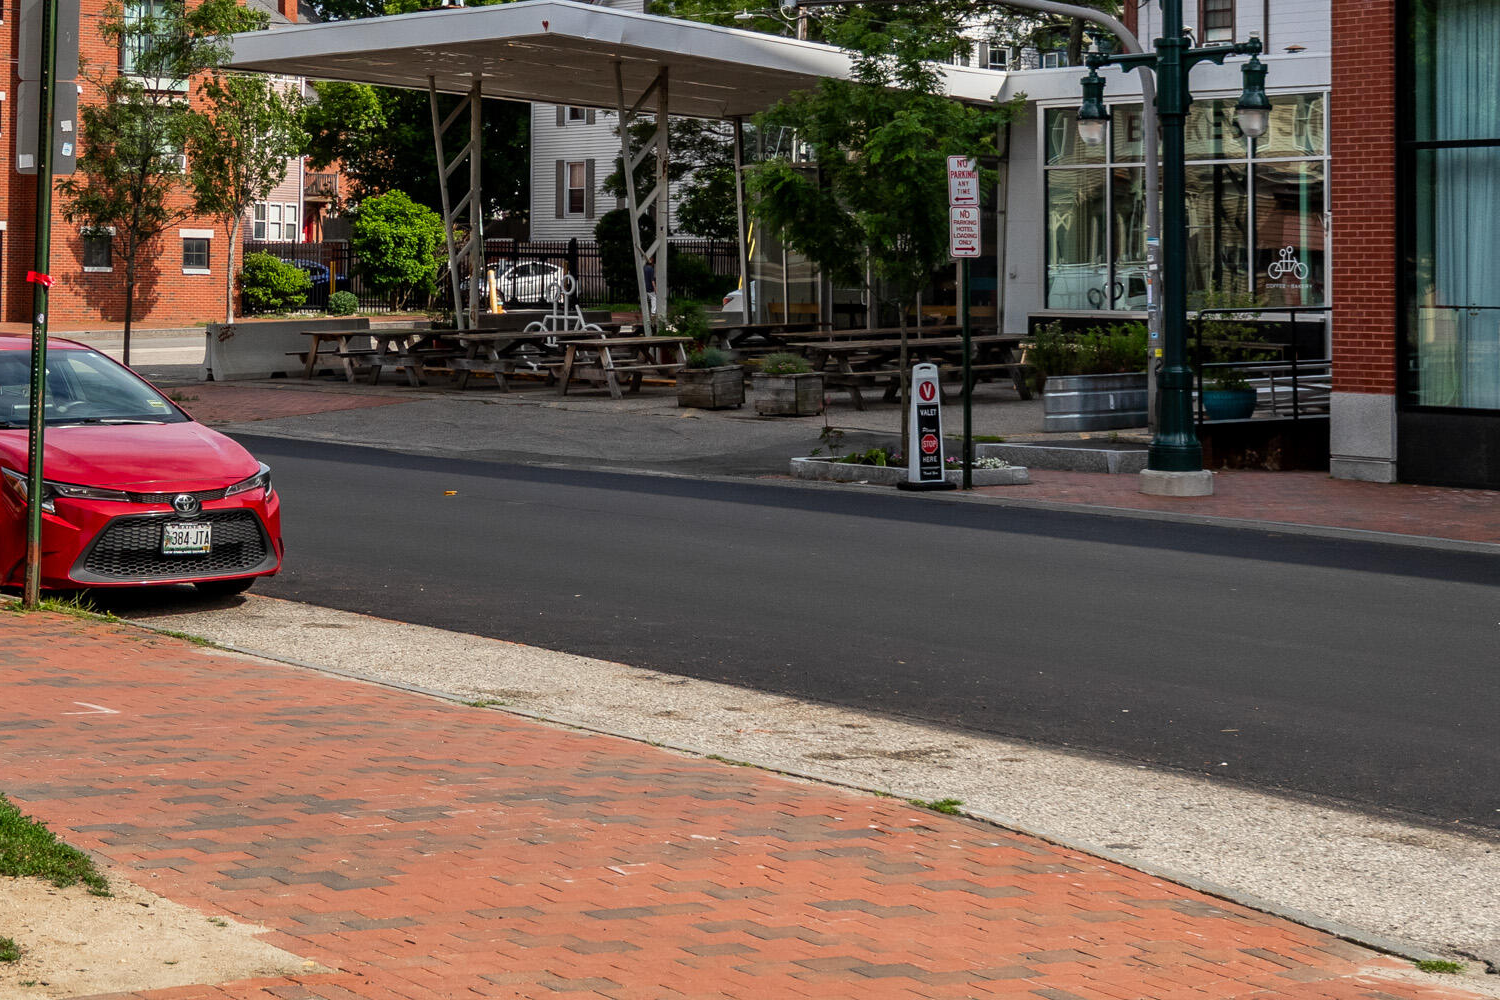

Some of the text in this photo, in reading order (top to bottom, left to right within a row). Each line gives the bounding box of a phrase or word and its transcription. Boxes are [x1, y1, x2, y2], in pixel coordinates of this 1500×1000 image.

[957, 160, 968, 168] NO
[950, 170, 976, 179] PARKING
[923, 383, 931, 399] V
[920, 409, 937, 417] VALET
[923, 440, 937, 448] STOP
